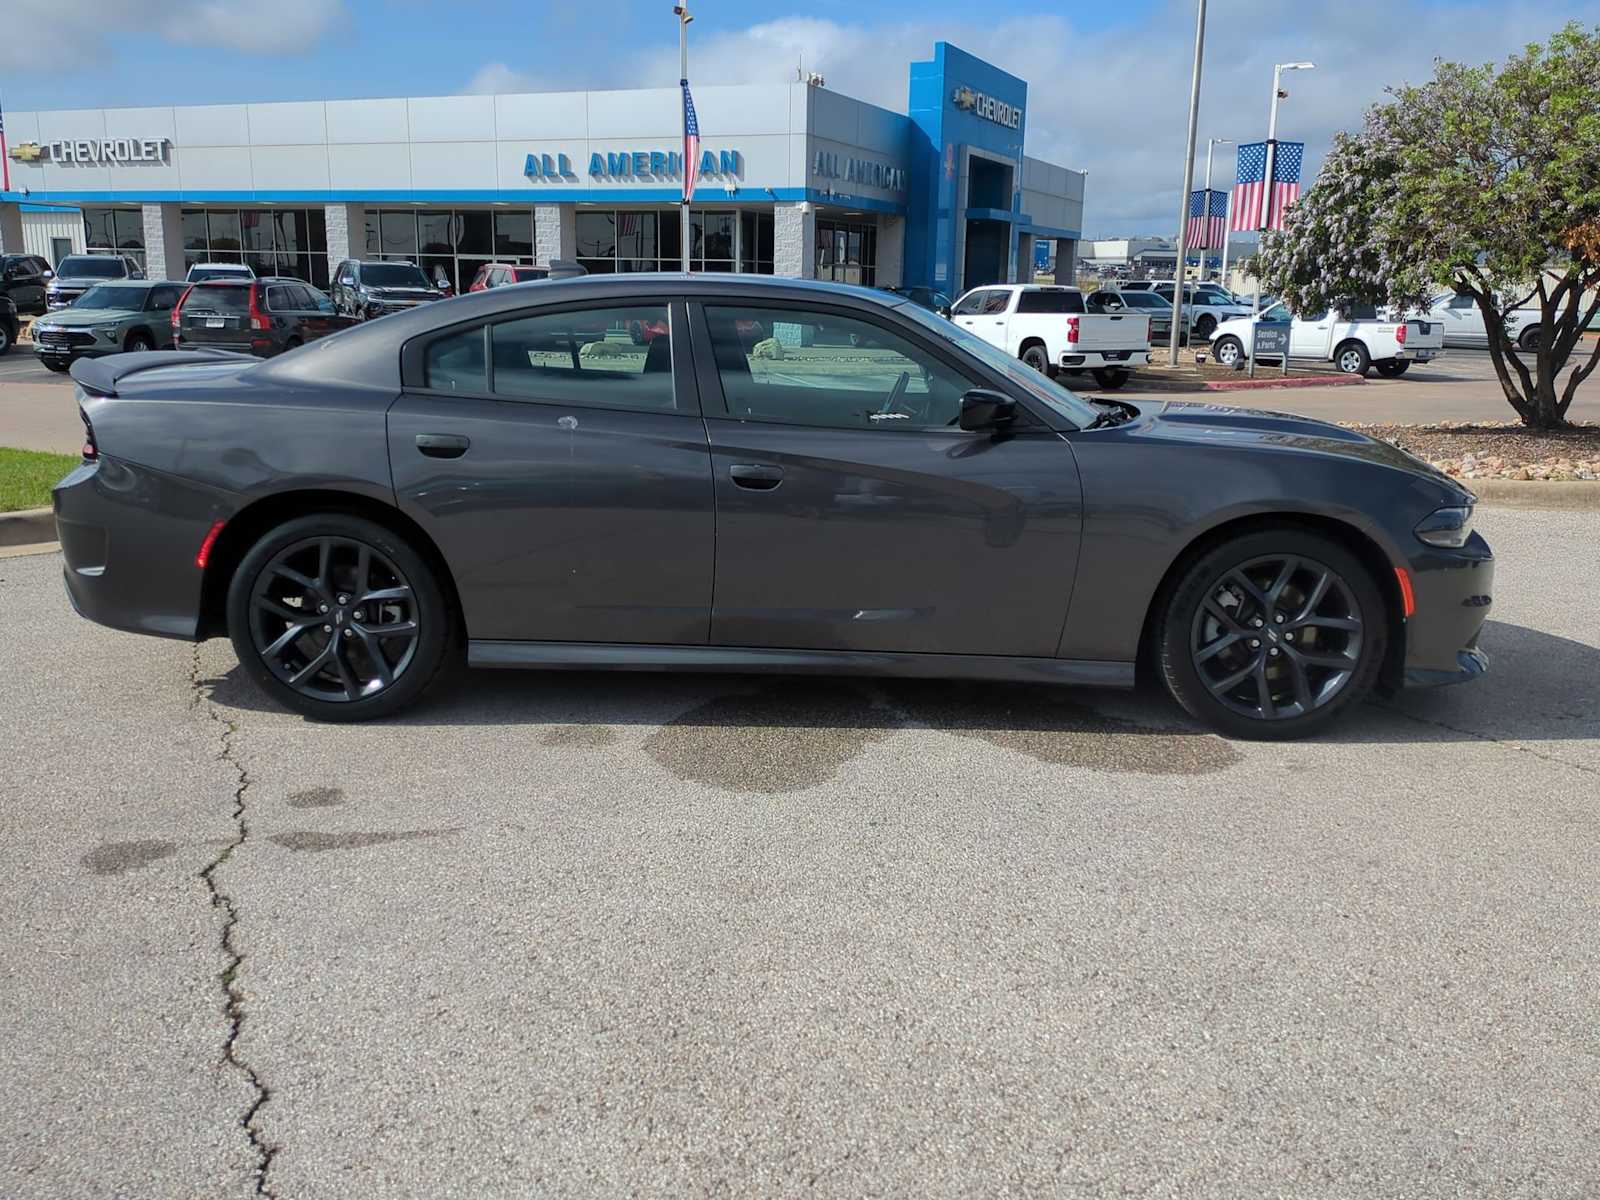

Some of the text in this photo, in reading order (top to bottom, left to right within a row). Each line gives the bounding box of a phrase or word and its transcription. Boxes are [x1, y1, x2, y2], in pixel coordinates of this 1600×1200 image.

[976, 92, 1023, 129] CHEVROLET
[50, 138, 168, 162] CHEVROLET
[524, 153, 573, 177] ALL
[813, 152, 840, 178] ALL
[1257, 330, 1278, 338] Service
[1262, 341, 1276, 350] Parts
